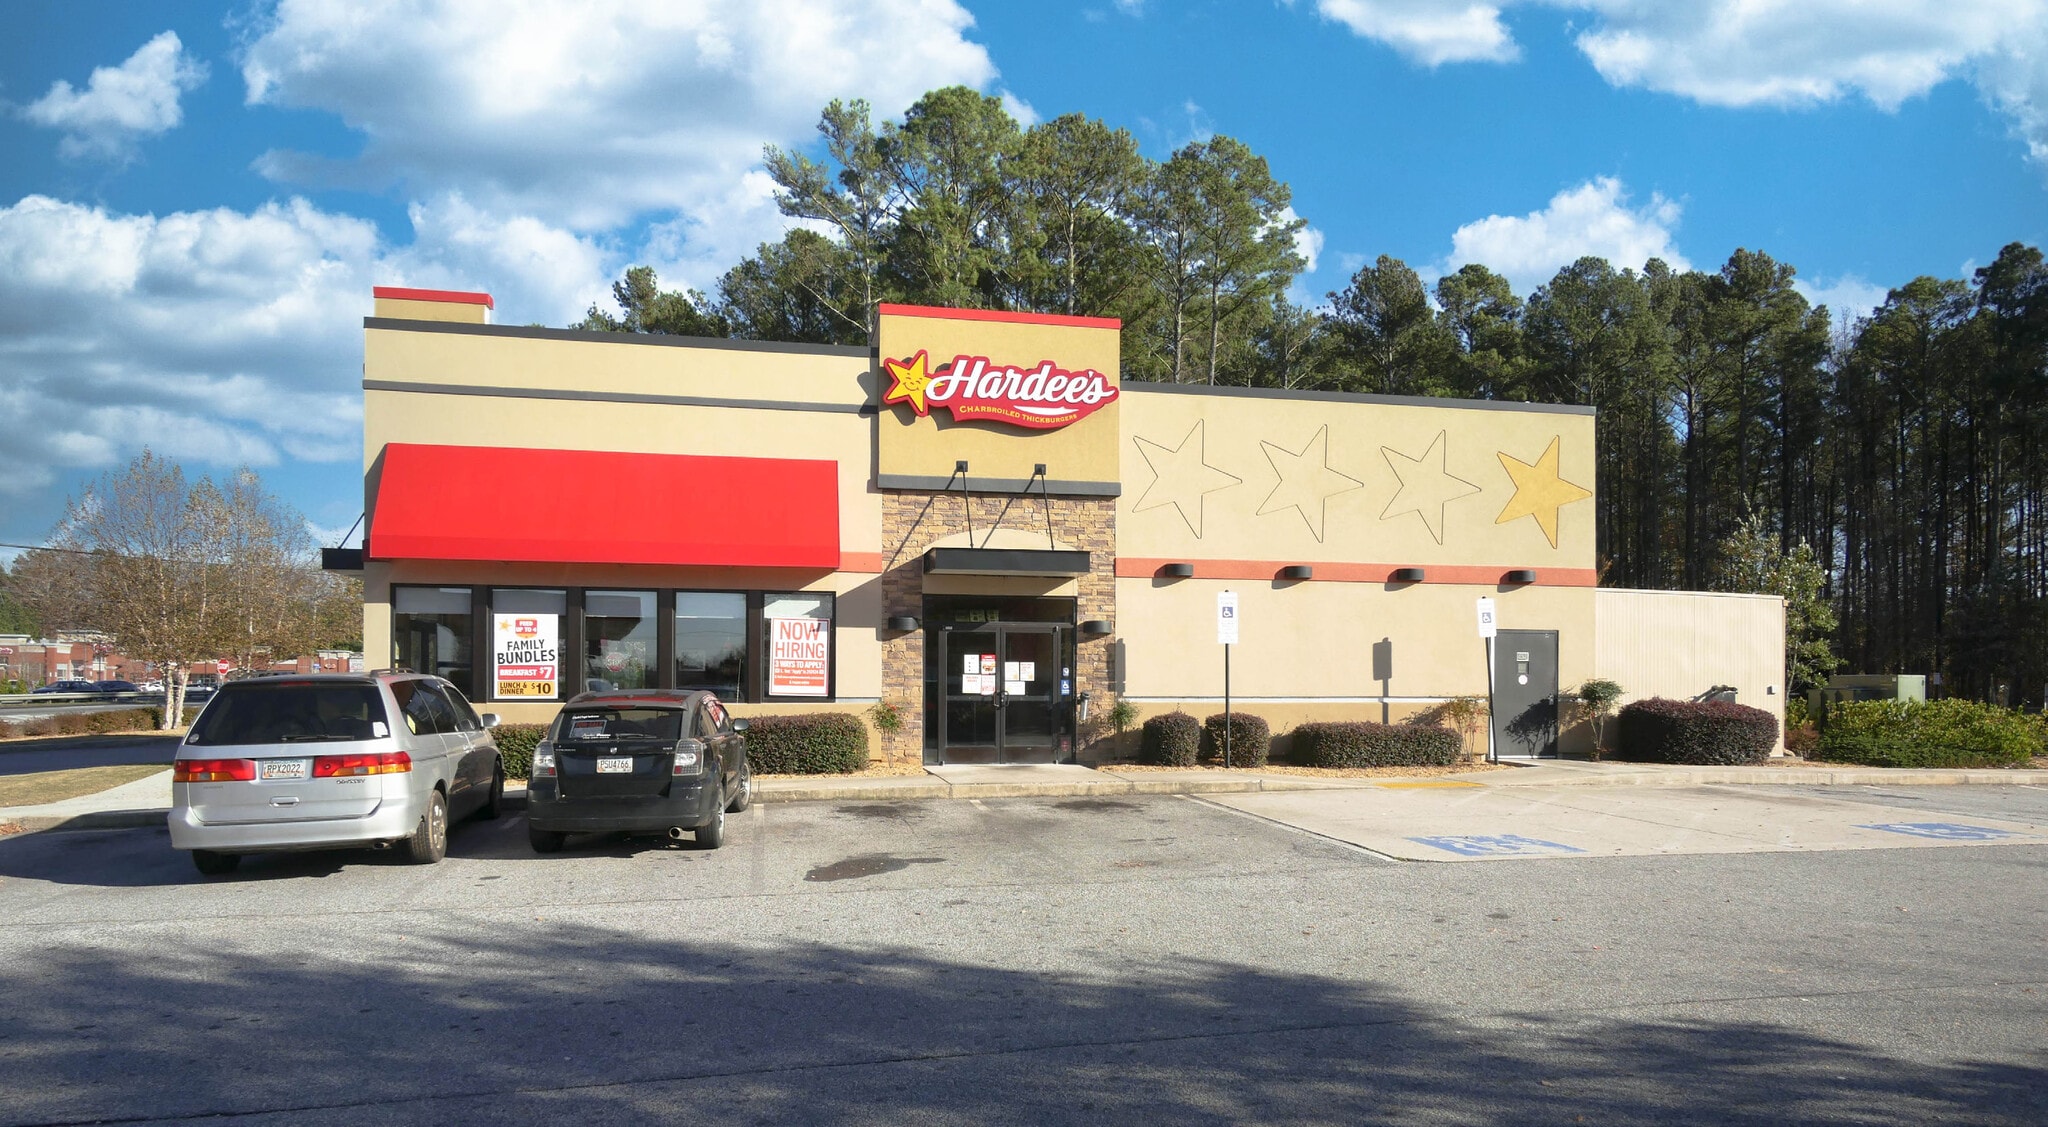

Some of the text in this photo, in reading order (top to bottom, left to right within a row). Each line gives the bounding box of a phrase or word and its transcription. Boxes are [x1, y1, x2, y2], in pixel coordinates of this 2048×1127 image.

[925, 360, 1115, 404] Hardee's
[959, 405, 1077, 424] CHARBROILED THICKBURGERS
[780, 621, 821, 640] NOW
[507, 639, 545, 651] FAMILY
[775, 641, 825, 658] HIRING
[497, 649, 556, 664] BUNDLES
